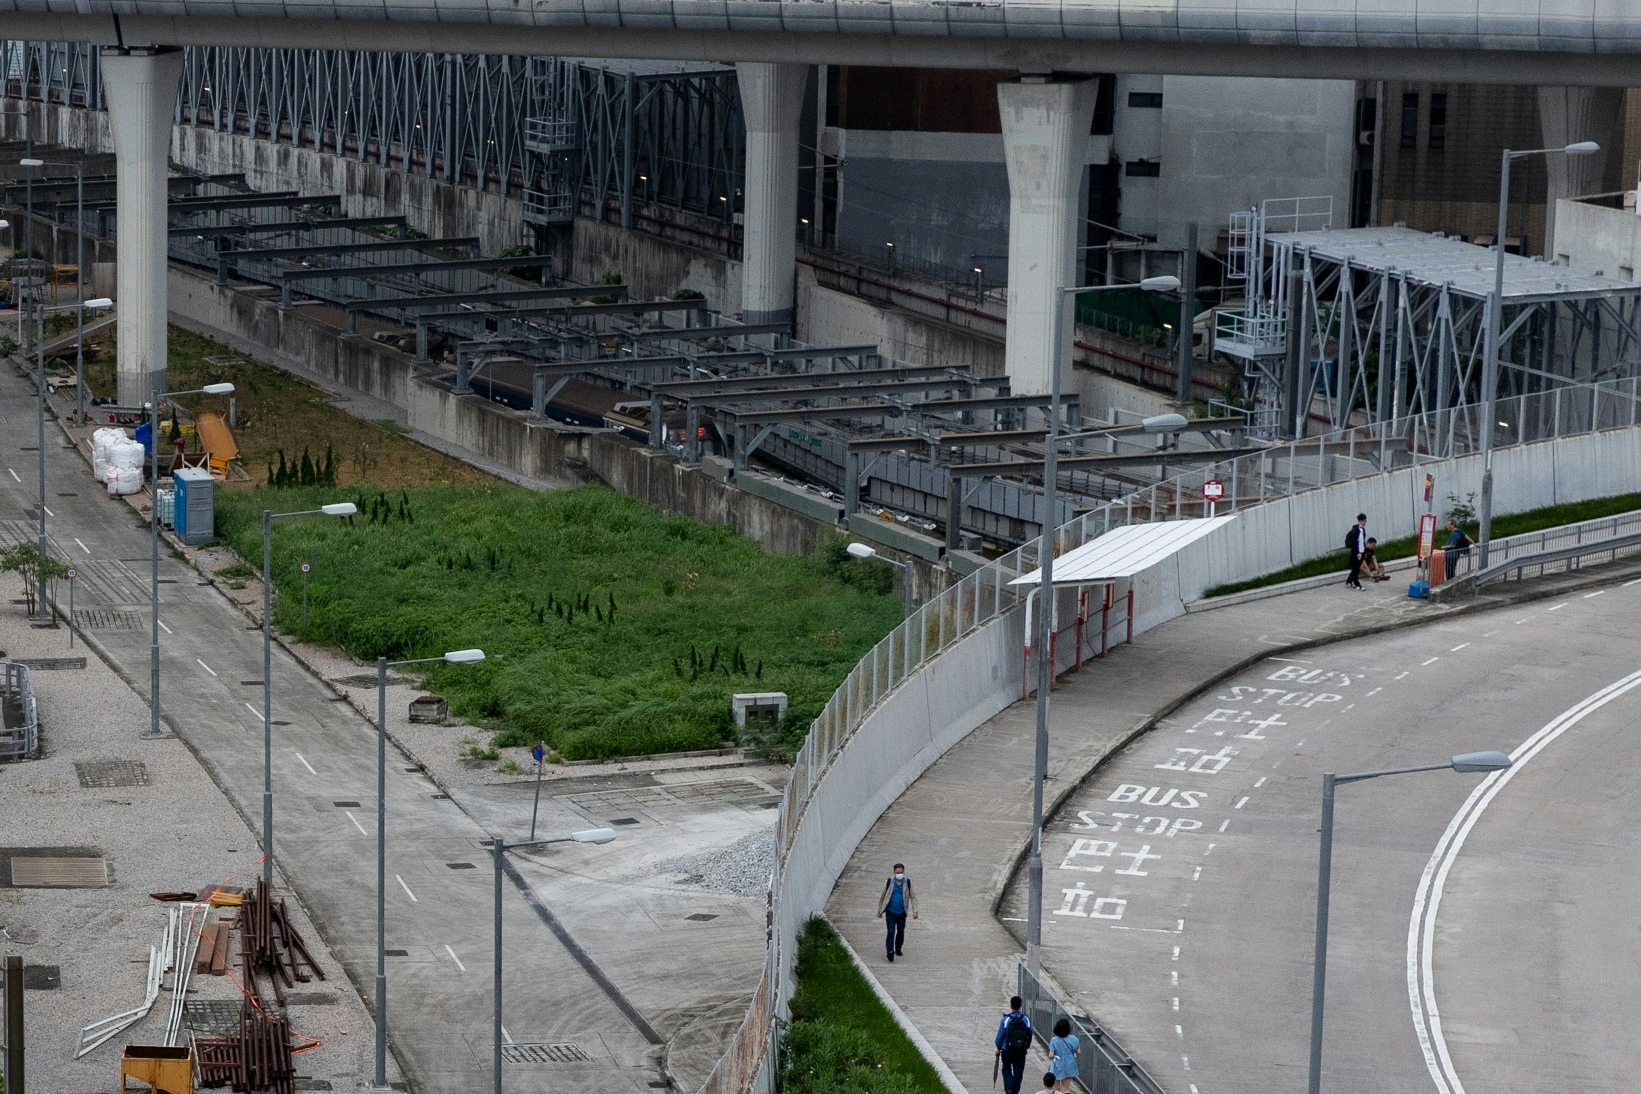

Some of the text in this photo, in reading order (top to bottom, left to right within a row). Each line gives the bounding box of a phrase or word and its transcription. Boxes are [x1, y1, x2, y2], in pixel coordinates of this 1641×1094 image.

[1217, 686, 1343, 708] STOP
[1107, 784, 1208, 809] BUS
[1069, 810, 1203, 838] STOP
[1058, 838, 1162, 877] 巴士
[1052, 881, 1128, 921] 站
